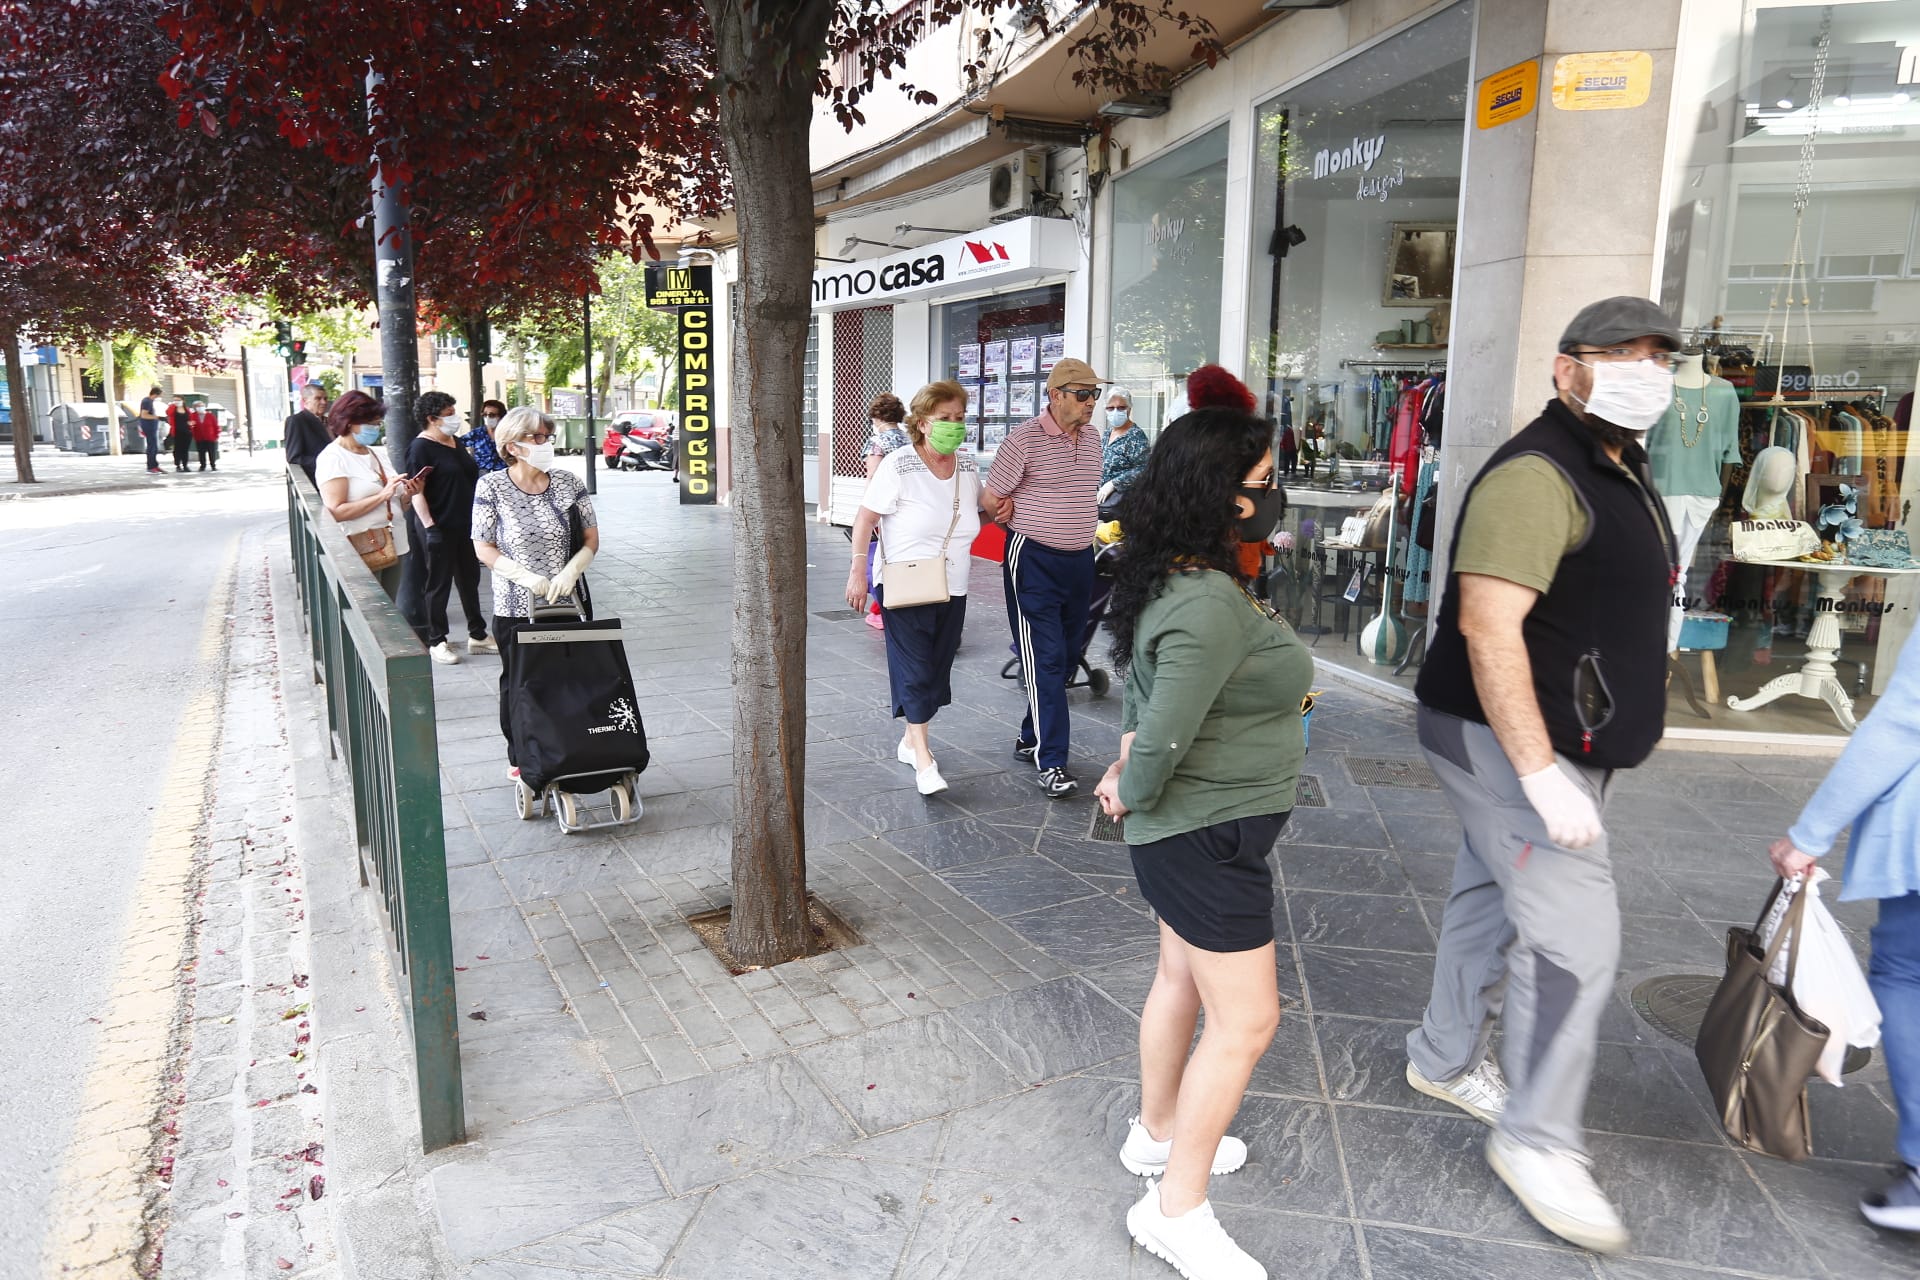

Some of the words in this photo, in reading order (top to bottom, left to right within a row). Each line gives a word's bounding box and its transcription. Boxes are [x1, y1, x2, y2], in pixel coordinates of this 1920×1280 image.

[1314, 134, 1385, 180] Monkys
[1356, 167, 1404, 203] designs
[1144, 216, 1186, 246] Monkys
[655, 290, 689, 298] DINERO
[690, 289, 704, 297] YA
[683, 311, 709, 432] COMPRO
[1815, 597, 1894, 613] Monkys
[587, 725, 616, 735] THERMO
